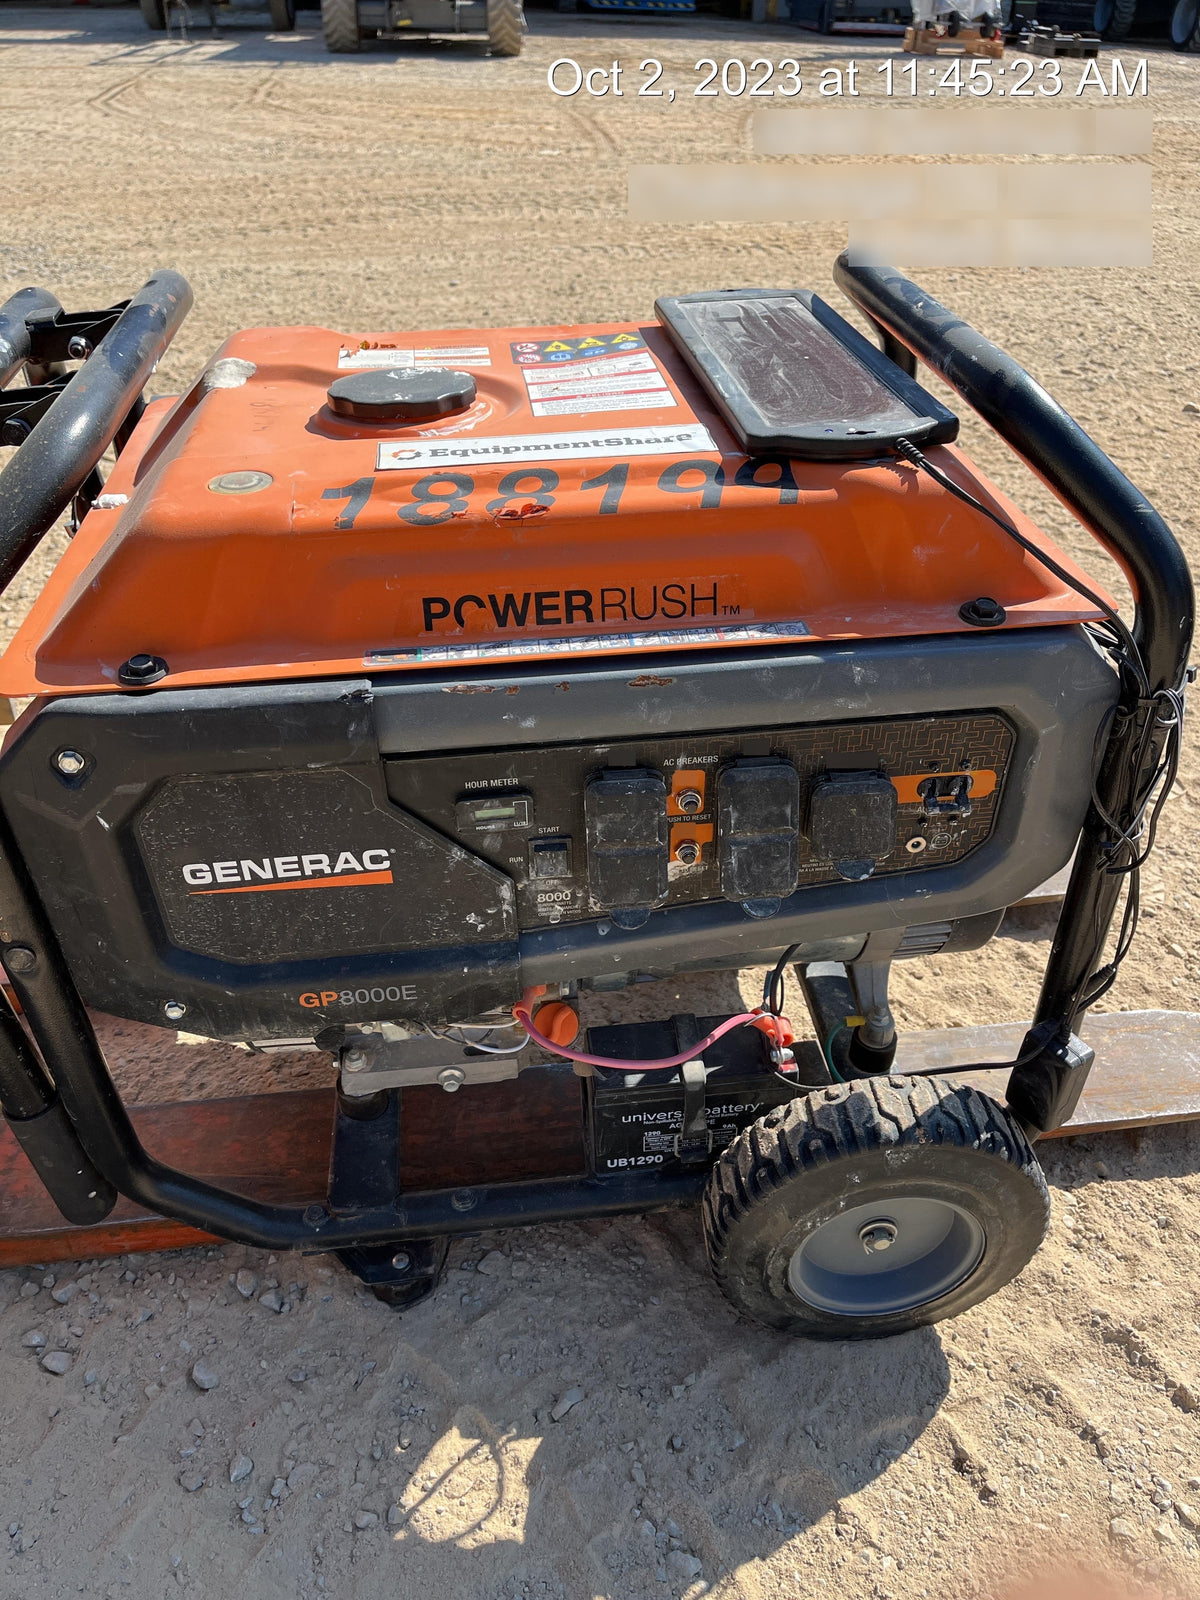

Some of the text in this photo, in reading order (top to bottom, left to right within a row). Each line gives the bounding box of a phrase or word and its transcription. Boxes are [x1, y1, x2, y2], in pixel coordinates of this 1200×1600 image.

[429, 432, 693, 458] EquipmentShare
[320, 457, 799, 530] 188199
[663, 755, 719, 767] AC BREAKERS
[464, 777, 519, 790] HOUR METER
[692, 813, 712, 821] RESET
[538, 826, 560, 834] START
[509, 855, 524, 864] RUN
[182, 849, 391, 885] GENERAC
[537, 891, 571, 903] 8000
[299, 984, 418, 1008] GP8000E
[621, 1109, 684, 1123] univers
[606, 1154, 664, 1168] UB1290
